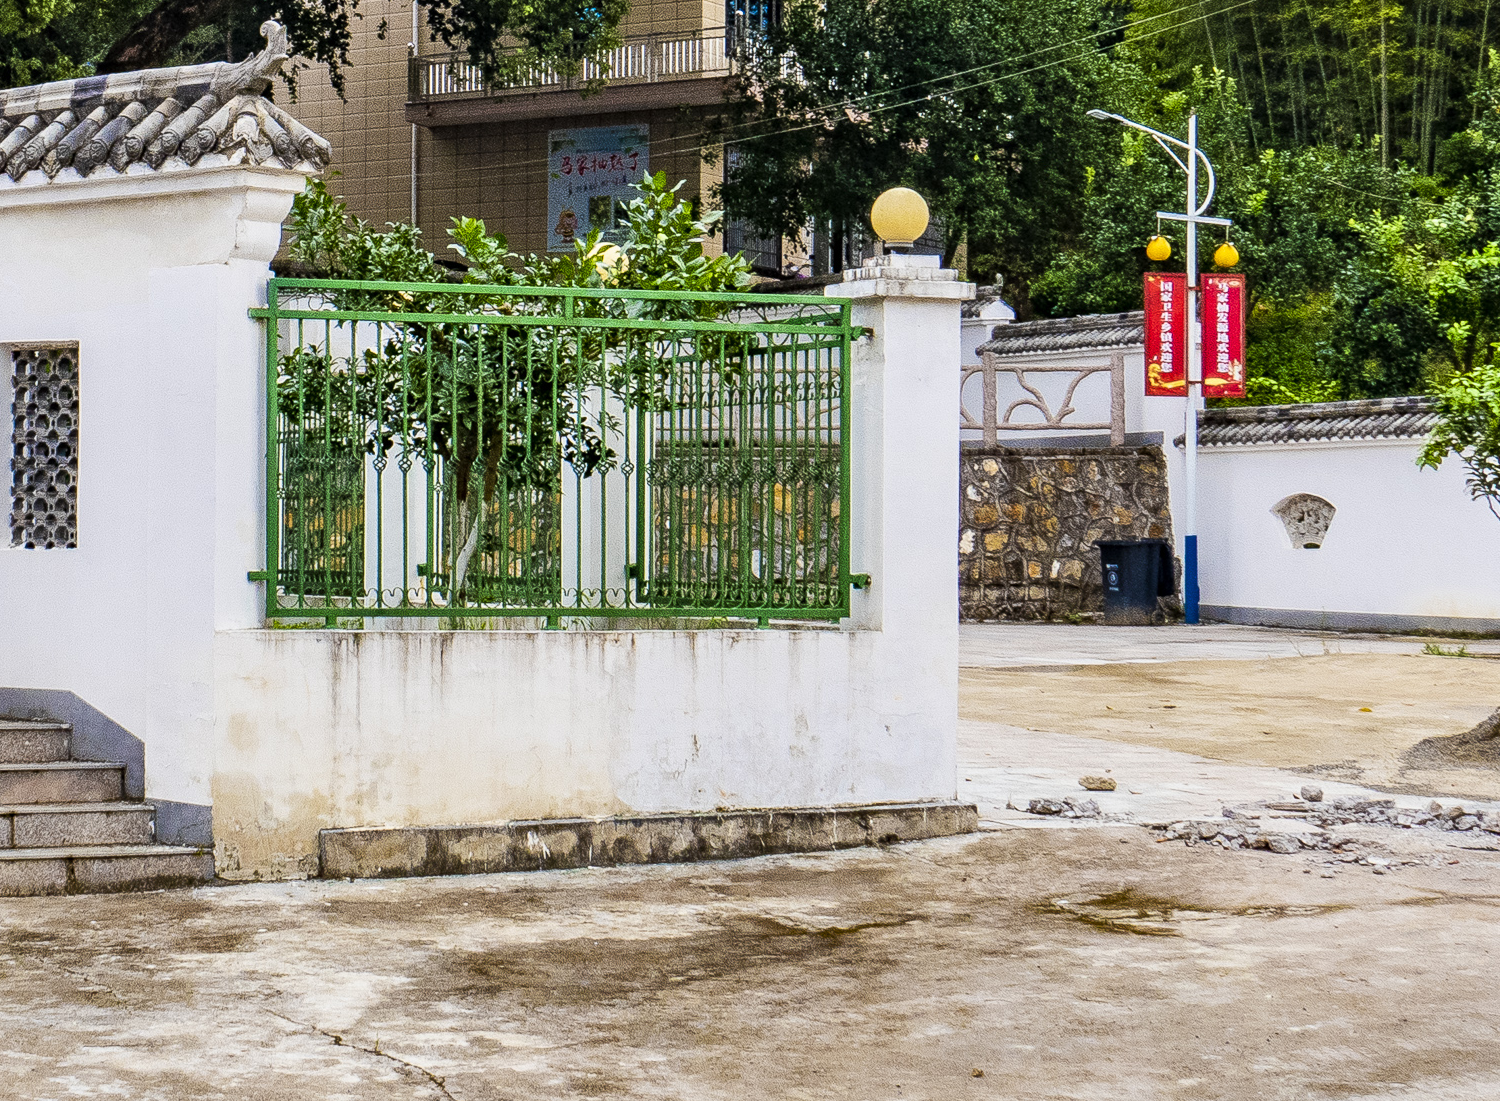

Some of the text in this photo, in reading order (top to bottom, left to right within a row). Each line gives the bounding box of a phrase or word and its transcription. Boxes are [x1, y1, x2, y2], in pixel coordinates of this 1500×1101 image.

[560, 152, 639, 176] 马家柚熟了
[1160, 281, 1173, 373] 国家卫生乡镇欢迎您
[1216, 282, 1230, 373] 马家柚发源地欢迎您
